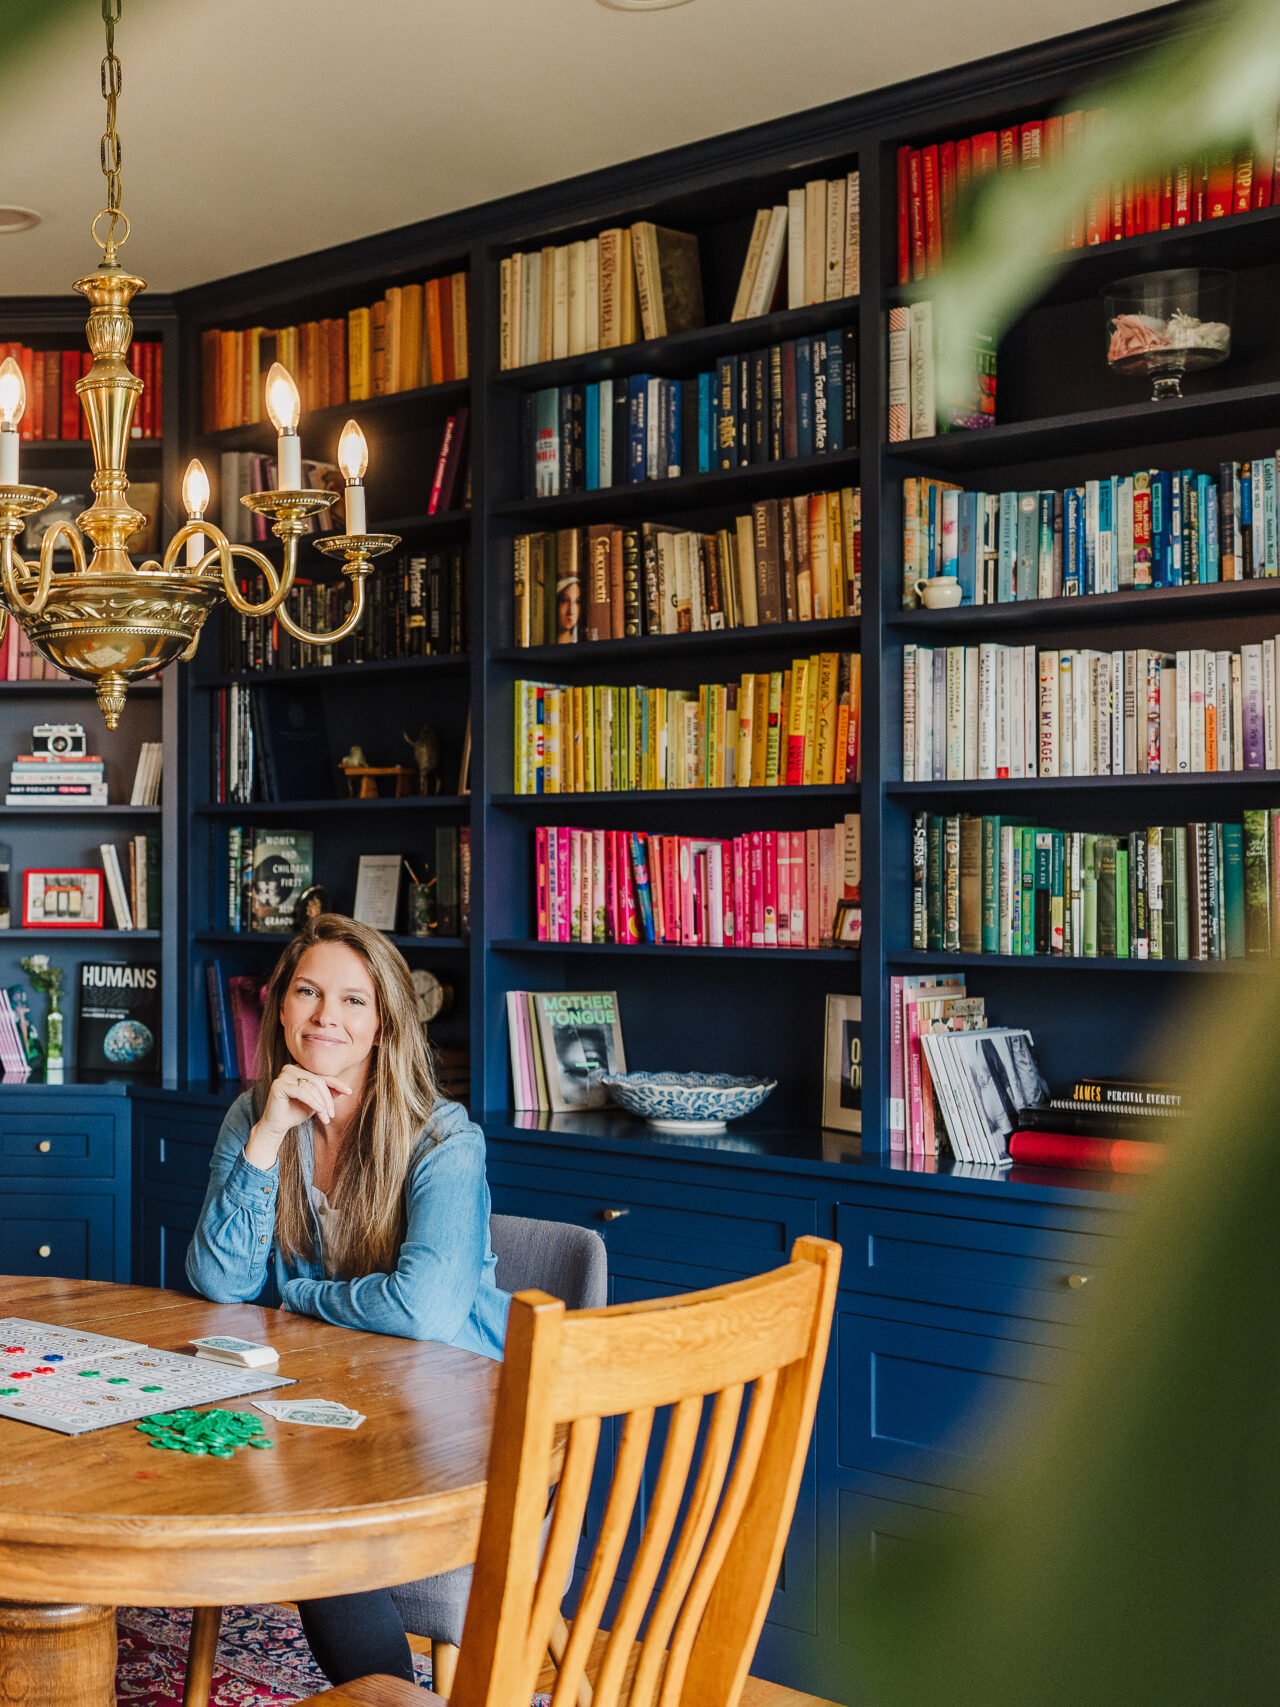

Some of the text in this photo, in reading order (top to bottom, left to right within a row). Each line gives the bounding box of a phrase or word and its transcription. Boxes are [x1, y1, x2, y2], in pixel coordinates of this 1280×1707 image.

[814, 374, 826, 449] Four Blind Mice
[1264, 463, 1274, 491] Cultish
[757, 506, 766, 548] FOLLETT
[594, 536, 610, 604] Giacometti
[1125, 690, 1135, 719] BETTER
[1206, 687, 1214, 698] Ng
[1042, 686, 1052, 763] ALL MY RAGE
[848, 745, 856, 757] UP
[266, 836, 296, 846] WOMEN
[914, 828, 926, 866] SIRENS
[272, 864, 309, 874] CHILDREN
[1149, 846, 1157, 907] ANNE LAMOTT
[280, 878, 302, 888] FIRST
[948, 868, 957, 918] DOLL PEOPLE
[82, 966, 157, 989] HUMANS
[543, 995, 614, 1011] MOTHER
[545, 1010, 616, 1026] TONGUE
[1073, 1084, 1182, 1106] JAMES PERCIVAL EVERETT
